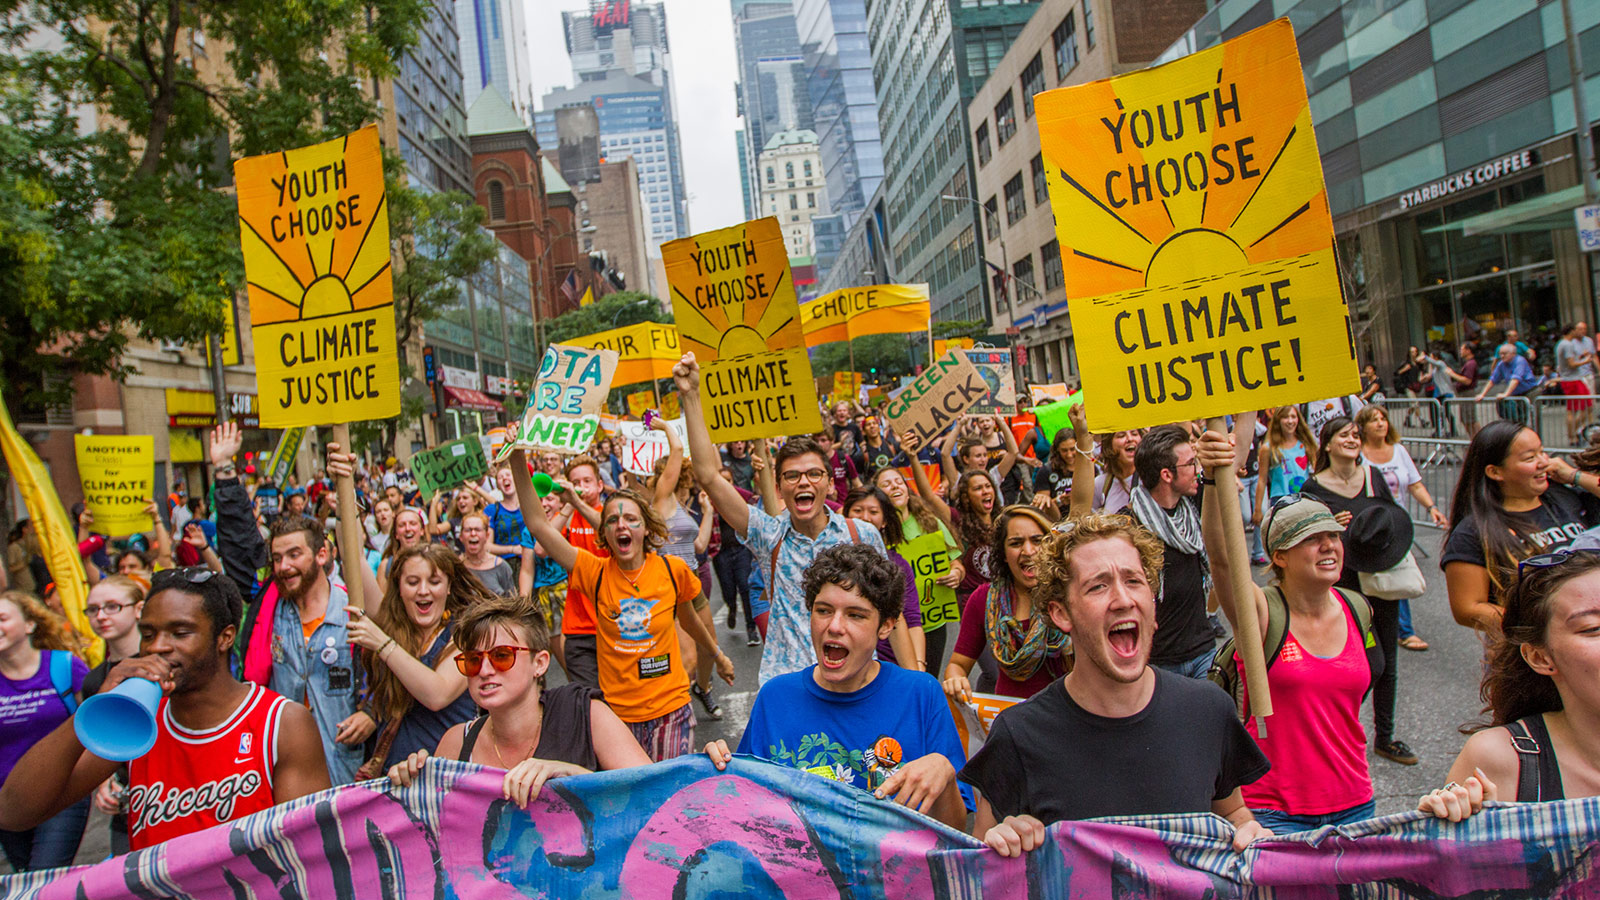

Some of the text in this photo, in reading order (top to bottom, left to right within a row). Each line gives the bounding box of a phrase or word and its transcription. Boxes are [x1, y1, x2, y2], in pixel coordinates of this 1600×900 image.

[592, 1, 629, 27] H&M
[1100, 82, 1242, 154] YOUTH
[271, 159, 348, 207] YOUTH
[1105, 136, 1261, 209] CHOOSE
[1400, 151, 1532, 209] STARBUCKS COFFEE
[270, 195, 362, 242] CHOOSE
[690, 240, 757, 276] YOUTH
[695, 273, 769, 310] CHOOSE
[812, 289, 878, 319] CHOICE
[1114, 279, 1297, 355] CLIMATE
[280, 319, 379, 367] CLIMATE
[279, 364, 380, 409] JUSTICE
[705, 360, 792, 398] CLIMATE
[887, 352, 960, 419] GREEN
[1118, 338, 1305, 410] JUSTICE!
[529, 382, 587, 414] RE
[710, 394, 798, 430] JUSTICE!
[85, 446, 141, 454] ANOTHER
[414, 450, 446, 473] OUR
[83, 480, 147, 490] CLIMATE
[104, 469, 120, 477] for
[424, 452, 486, 490] FUTURE
[87, 494, 144, 505] ACTION
[652, 660, 668, 668] FUTURE
[129, 770, 261, 838] Chicago
